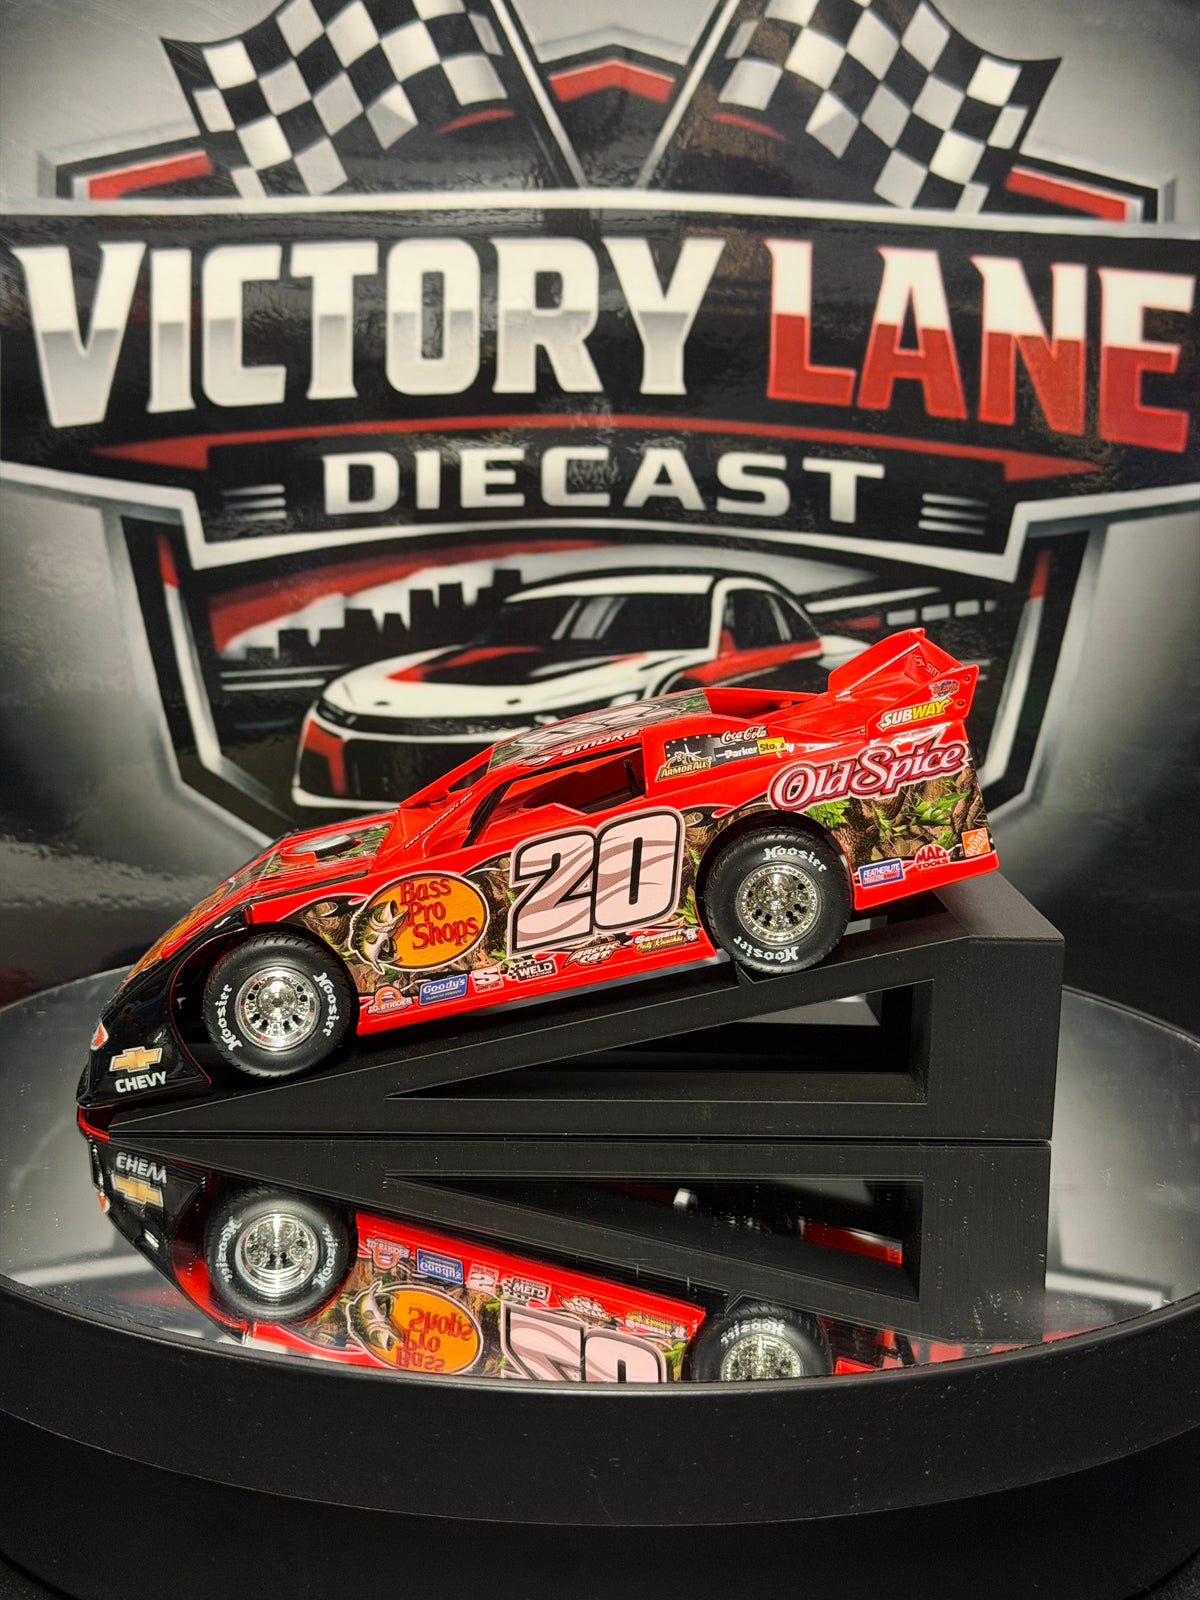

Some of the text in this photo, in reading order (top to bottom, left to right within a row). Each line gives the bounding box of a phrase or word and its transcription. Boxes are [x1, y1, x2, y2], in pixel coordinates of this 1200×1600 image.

[10, 237, 1197, 453] VICTORY LANE
[323, 446, 885, 524] DIECAST
[878, 698, 952, 730] SUBWAY
[771, 743, 967, 811] Old Spice
[763, 845, 827, 872] Hoosier
[916, 845, 947, 863] MAC
[399, 879, 451, 905] Bass
[510, 807, 686, 957] 20
[406, 901, 446, 925] Pro
[412, 917, 479, 950] Shops
[733, 936, 799, 963] Hoosier
[518, 962, 553, 976] WELD
[423, 978, 465, 994] Goody's
[215, 984, 243, 1050] Hoosier
[313, 972, 338, 1037] Hoosier
[114, 1071, 167, 1093] CHEVY
